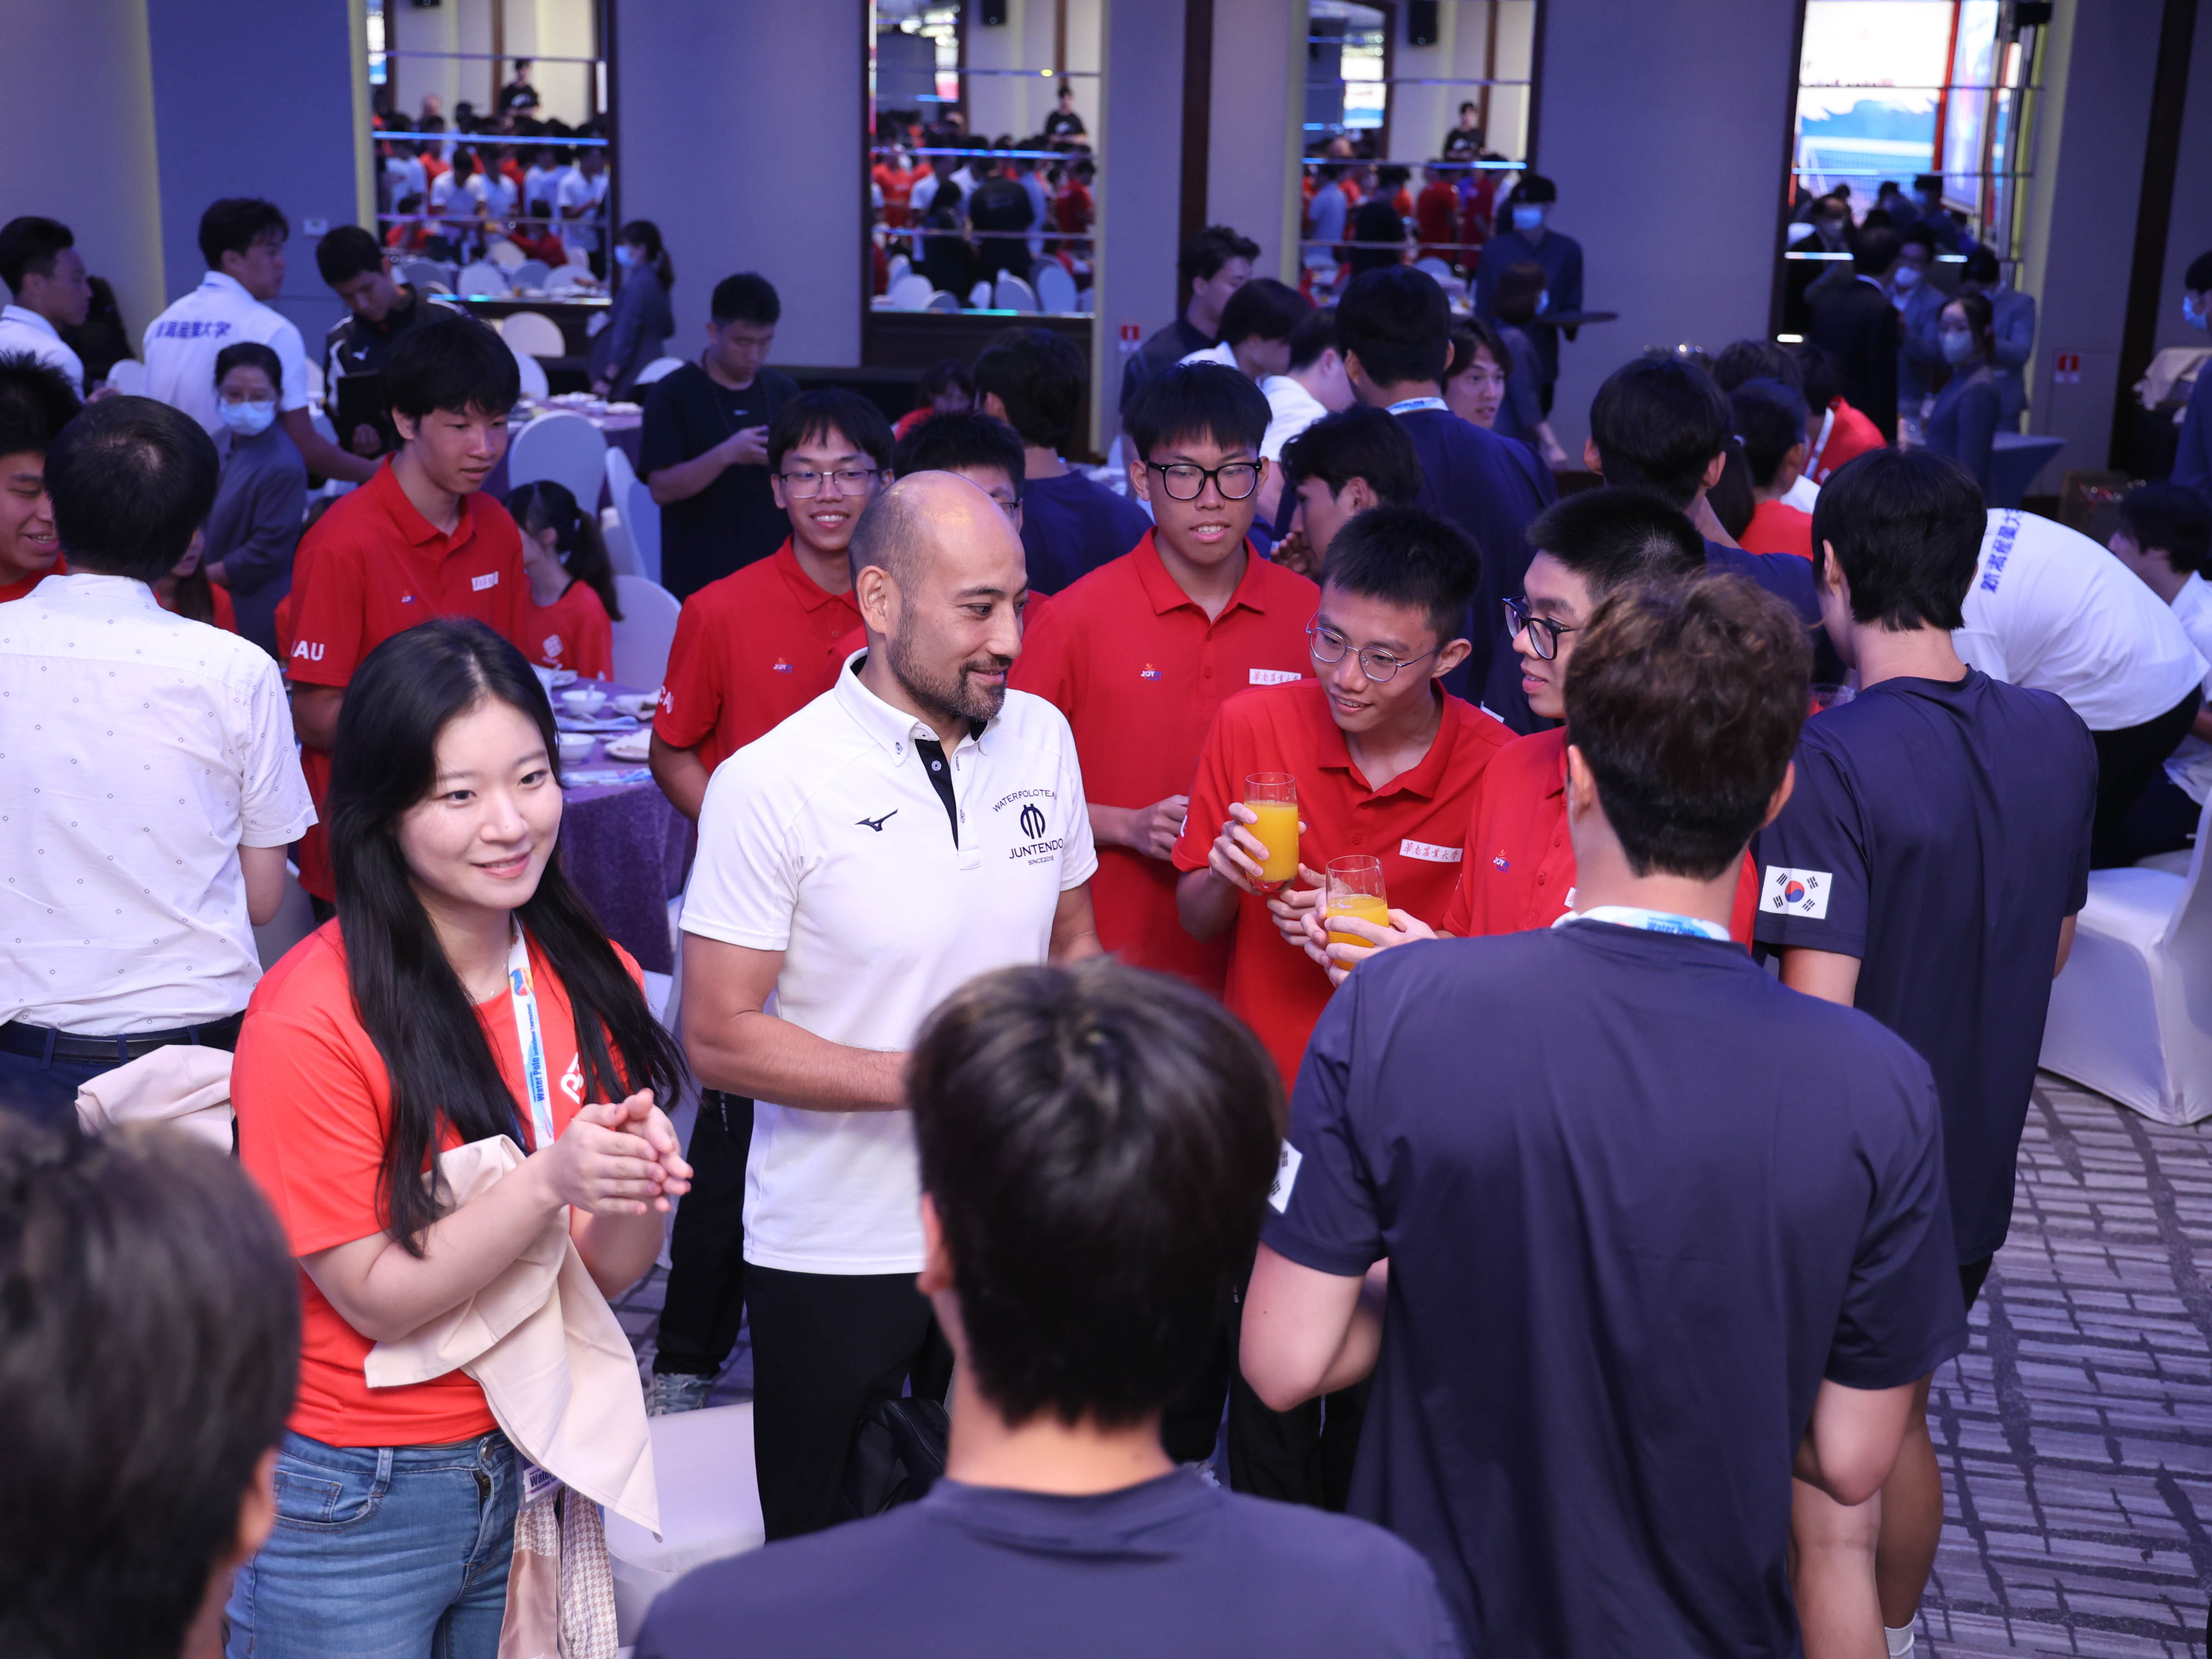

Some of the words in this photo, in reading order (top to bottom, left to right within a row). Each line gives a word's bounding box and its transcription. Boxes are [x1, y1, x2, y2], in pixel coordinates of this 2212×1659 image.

[1981, 508, 2021, 593] 新潟産業大
[291, 640, 325, 661] AU
[1009, 838, 1064, 859] JUNTENDO
[532, 1057, 541, 1075] Polo
[535, 1076, 545, 1101] Water
